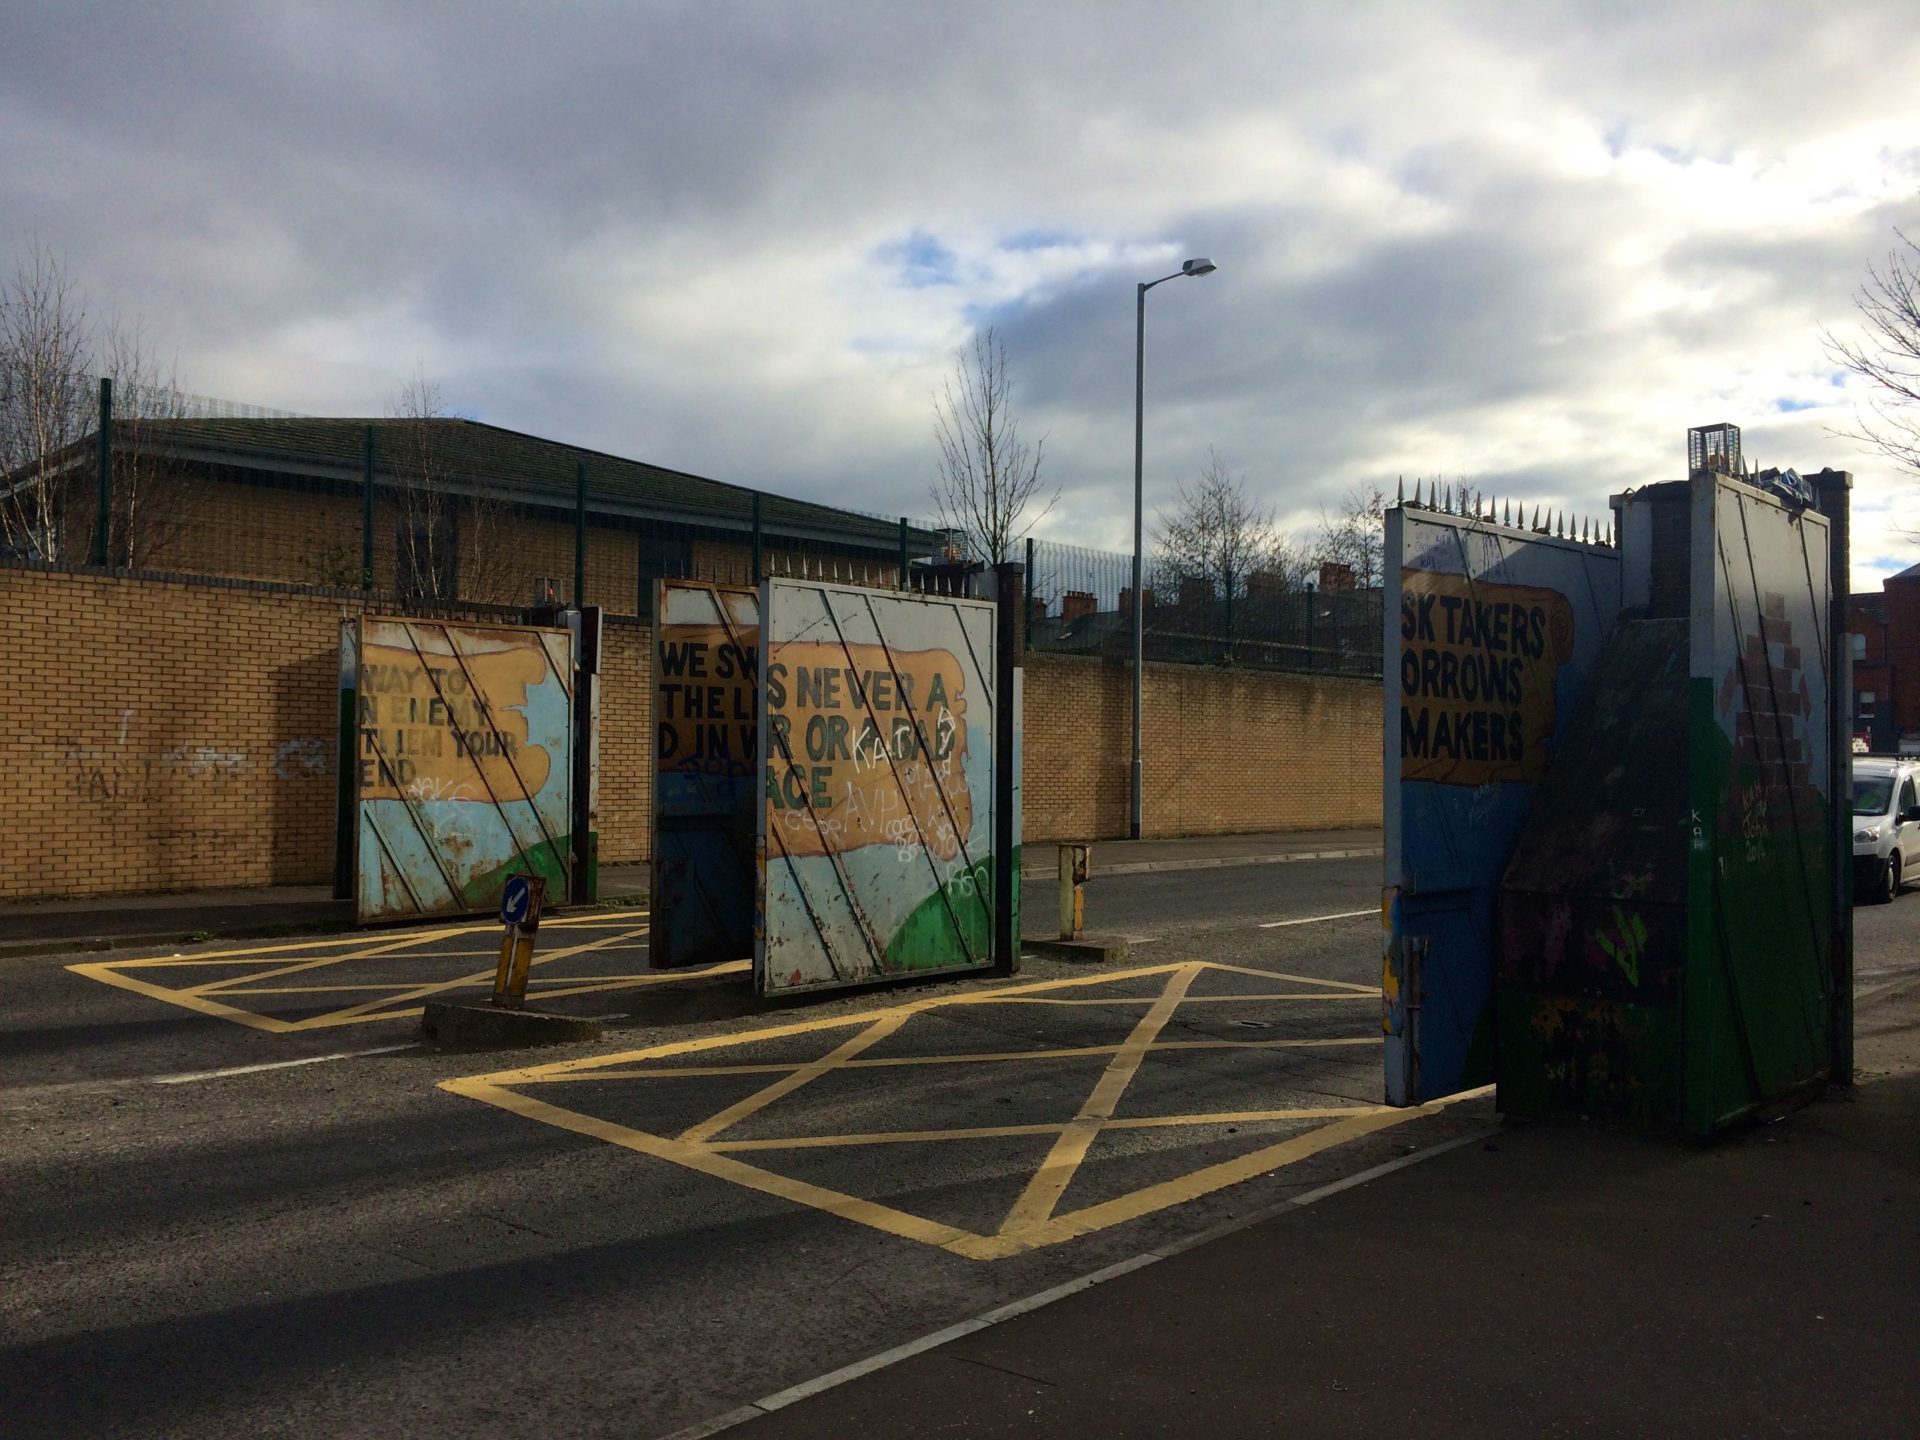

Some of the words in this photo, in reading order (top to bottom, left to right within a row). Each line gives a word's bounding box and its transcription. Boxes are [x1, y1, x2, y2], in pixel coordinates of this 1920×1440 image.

[1440, 596, 1545, 660] TAKERS
[659, 641, 709, 678] WE
[429, 668, 467, 695] TO
[796, 666, 915, 711] NEVER
[926, 673, 949, 712] A
[660, 684, 724, 719] THE
[452, 731, 517, 758] YOUR
[696, 724, 728, 759] IN
[805, 714, 850, 762] OR
[892, 717, 955, 762] BAD
[1401, 705, 1524, 760] MAKERS
[360, 759, 416, 787] END
